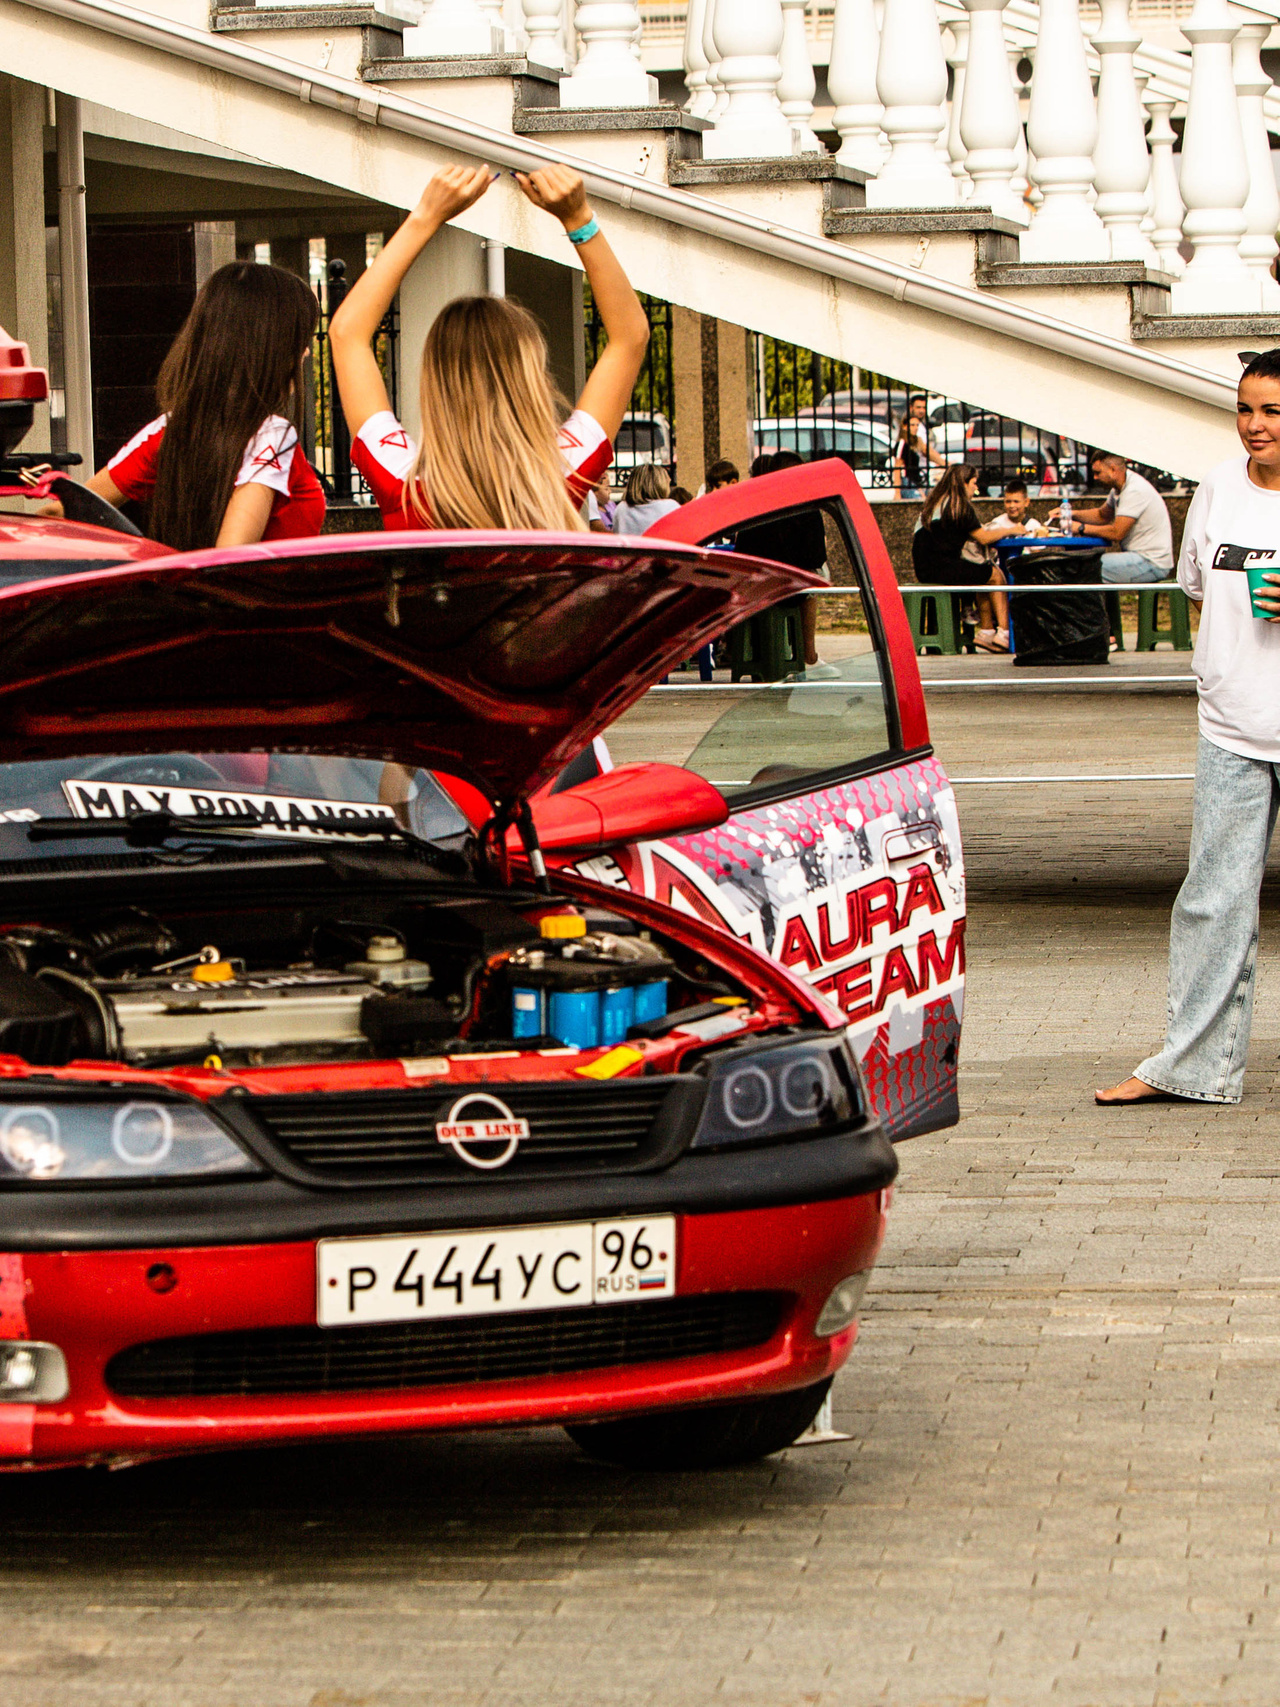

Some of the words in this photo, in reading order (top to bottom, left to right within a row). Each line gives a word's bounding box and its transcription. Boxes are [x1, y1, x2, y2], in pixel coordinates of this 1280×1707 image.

[75, 786, 172, 819] MAX
[778, 862, 946, 973] AURA
[441, 1126, 475, 1138] OUR
[601, 1226, 654, 1274] 96
[596, 1275, 637, 1295] RUS
